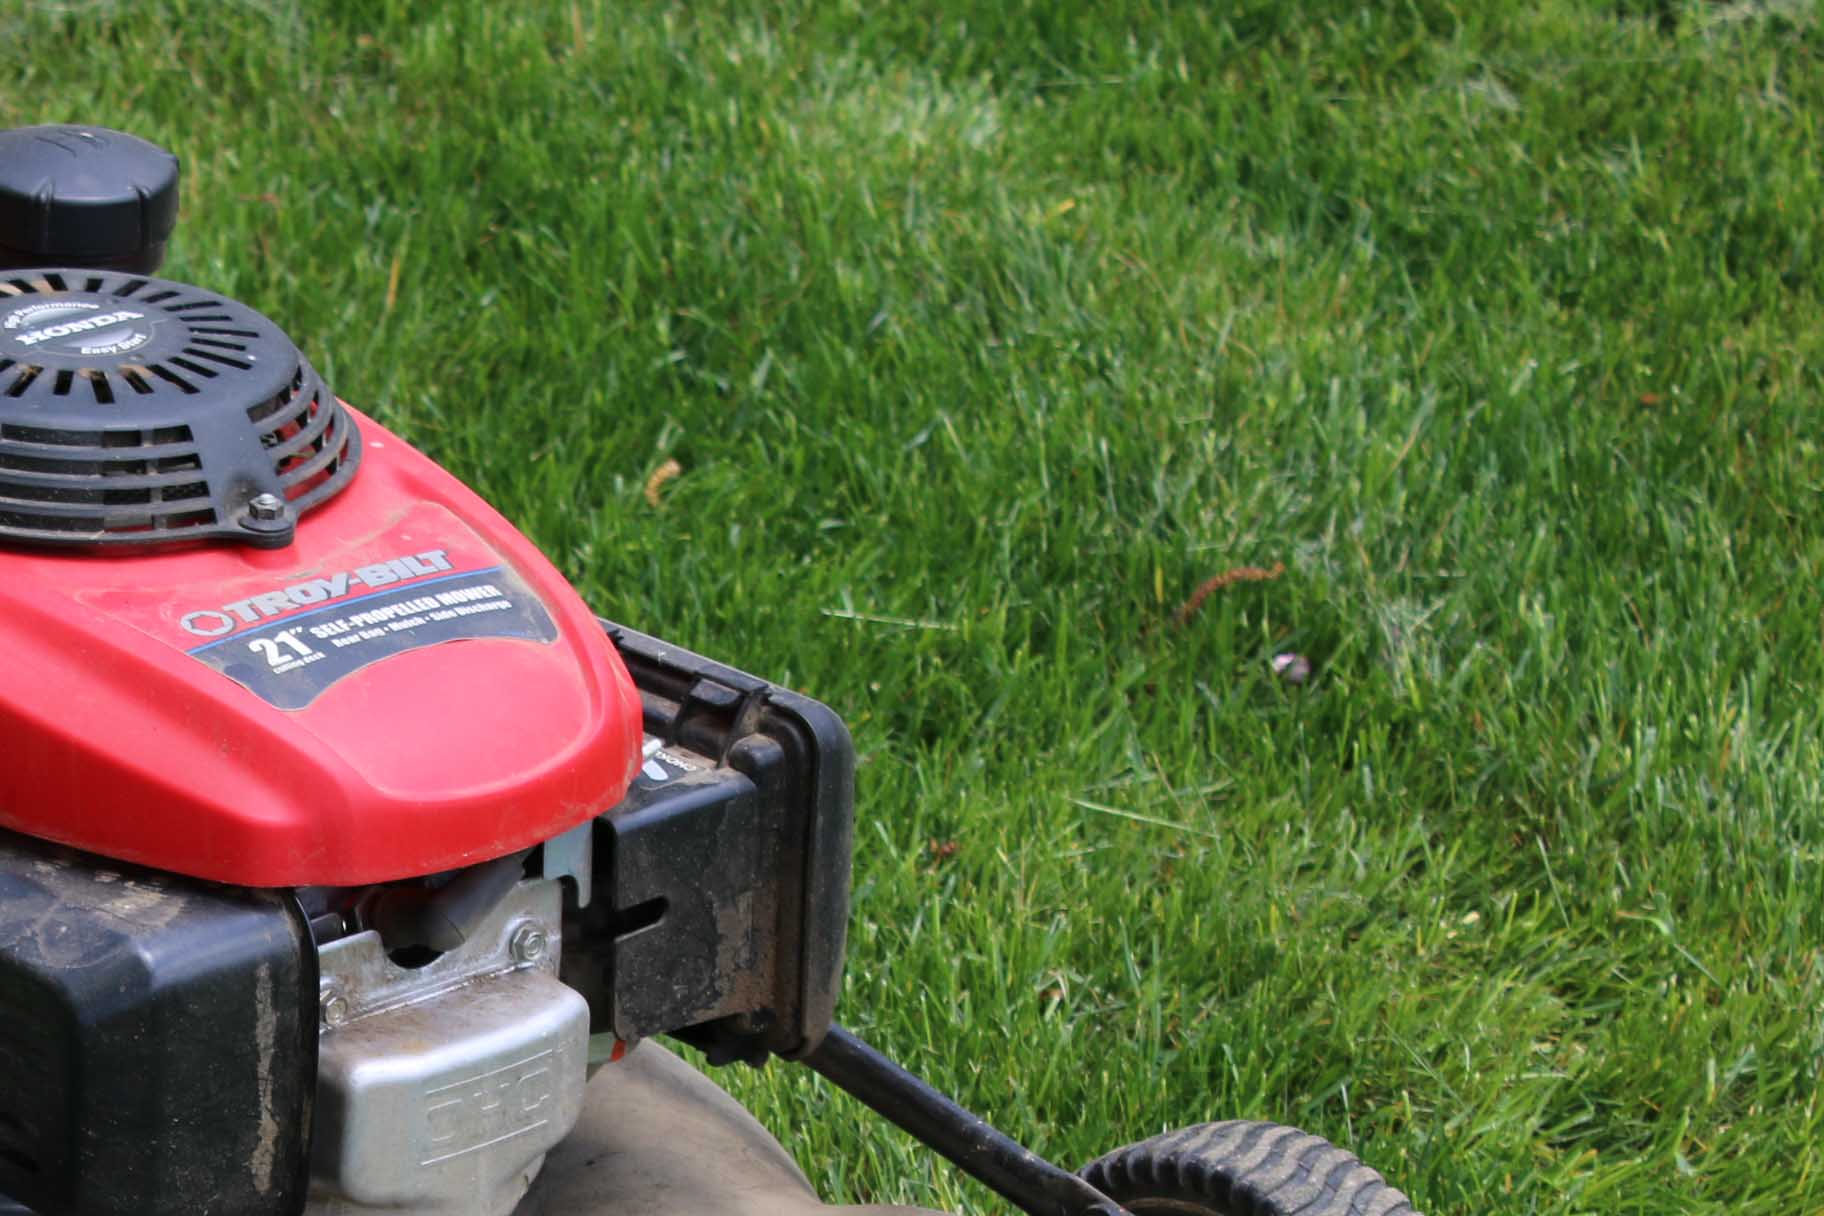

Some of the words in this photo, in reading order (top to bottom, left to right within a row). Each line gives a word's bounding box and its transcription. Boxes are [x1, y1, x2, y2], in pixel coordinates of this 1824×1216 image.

[15, 311, 144, 345] HONDA
[81, 345, 117, 354] Easy
[118, 333, 146, 349] Start
[221, 549, 454, 624] TROY-BILT
[309, 596, 440, 639] SELF-PROPELLED
[436, 584, 502, 606] MOWER
[331, 633, 362, 648] Rear
[360, 627, 386, 641] Bag
[387, 616, 426, 632] Mulch
[430, 610, 457, 622] Side
[456, 600, 513, 616] Discharge
